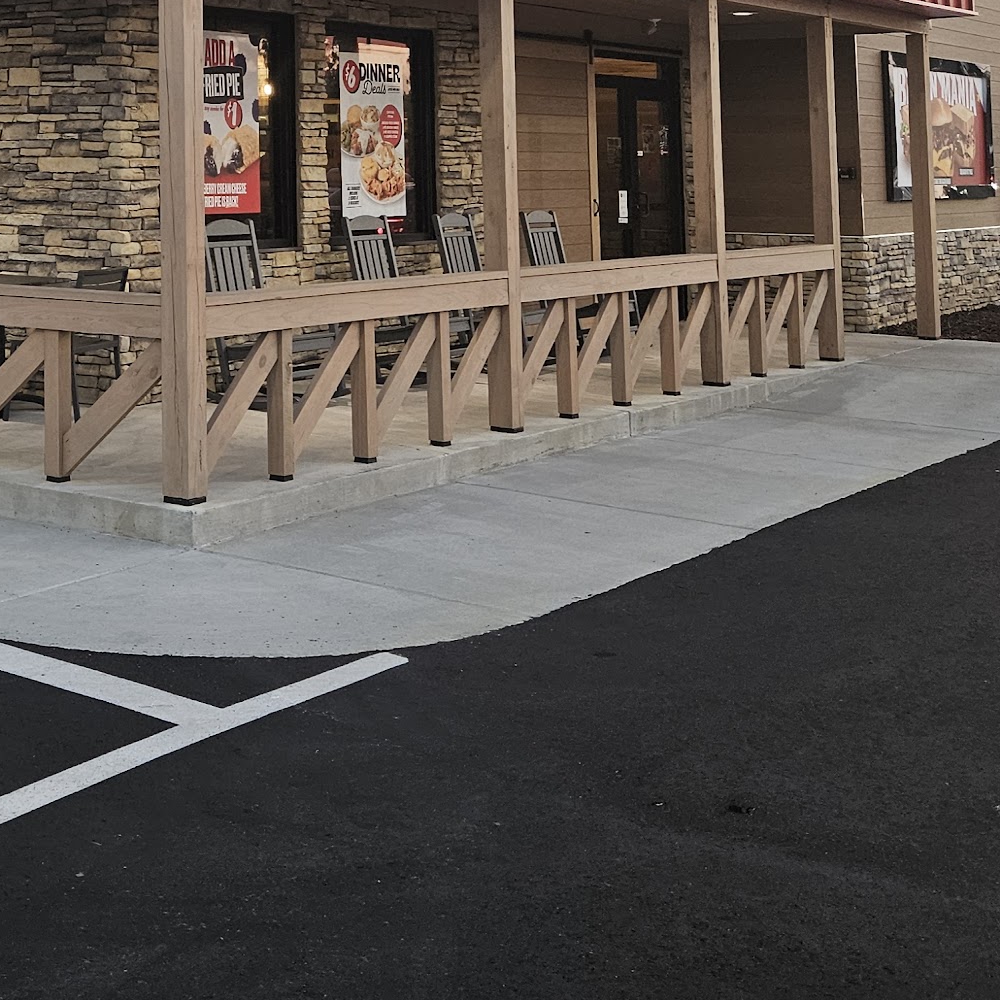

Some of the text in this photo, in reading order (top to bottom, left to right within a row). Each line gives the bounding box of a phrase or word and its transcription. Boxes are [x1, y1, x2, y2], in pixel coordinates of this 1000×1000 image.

[205, 38, 235, 66] ADD A
[226, 72, 241, 97] PIE
[345, 62, 401, 88] $6 DINNER
[362, 79, 387, 95] Deals
[939, 73, 978, 116] MANIA
[227, 101, 237, 126] $1
